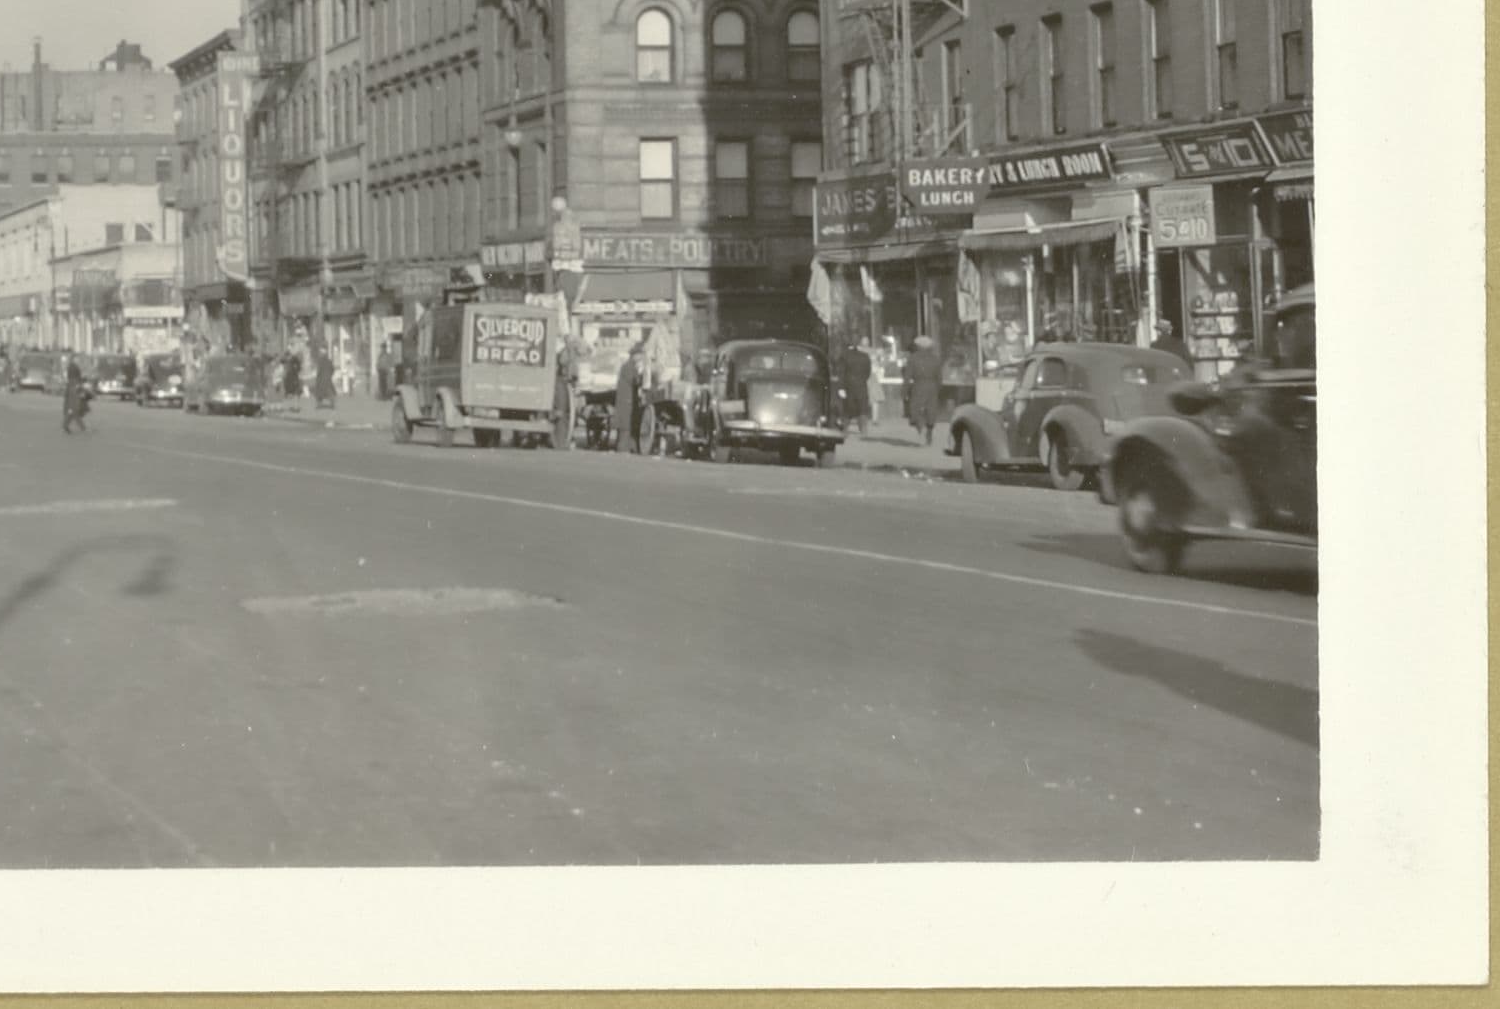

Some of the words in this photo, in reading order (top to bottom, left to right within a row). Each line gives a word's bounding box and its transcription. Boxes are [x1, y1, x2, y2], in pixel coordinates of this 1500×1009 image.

[222, 82, 245, 263] LIQUORS
[907, 166, 986, 187] BAKERY
[1017, 157, 1060, 181] LUNCH
[1061, 151, 1104, 177] ROOM
[919, 190, 975, 206] LUNCH
[582, 237, 654, 262] MEATS
[476, 317, 545, 346] SILVERCUP
[475, 346, 541, 364] BREAD
